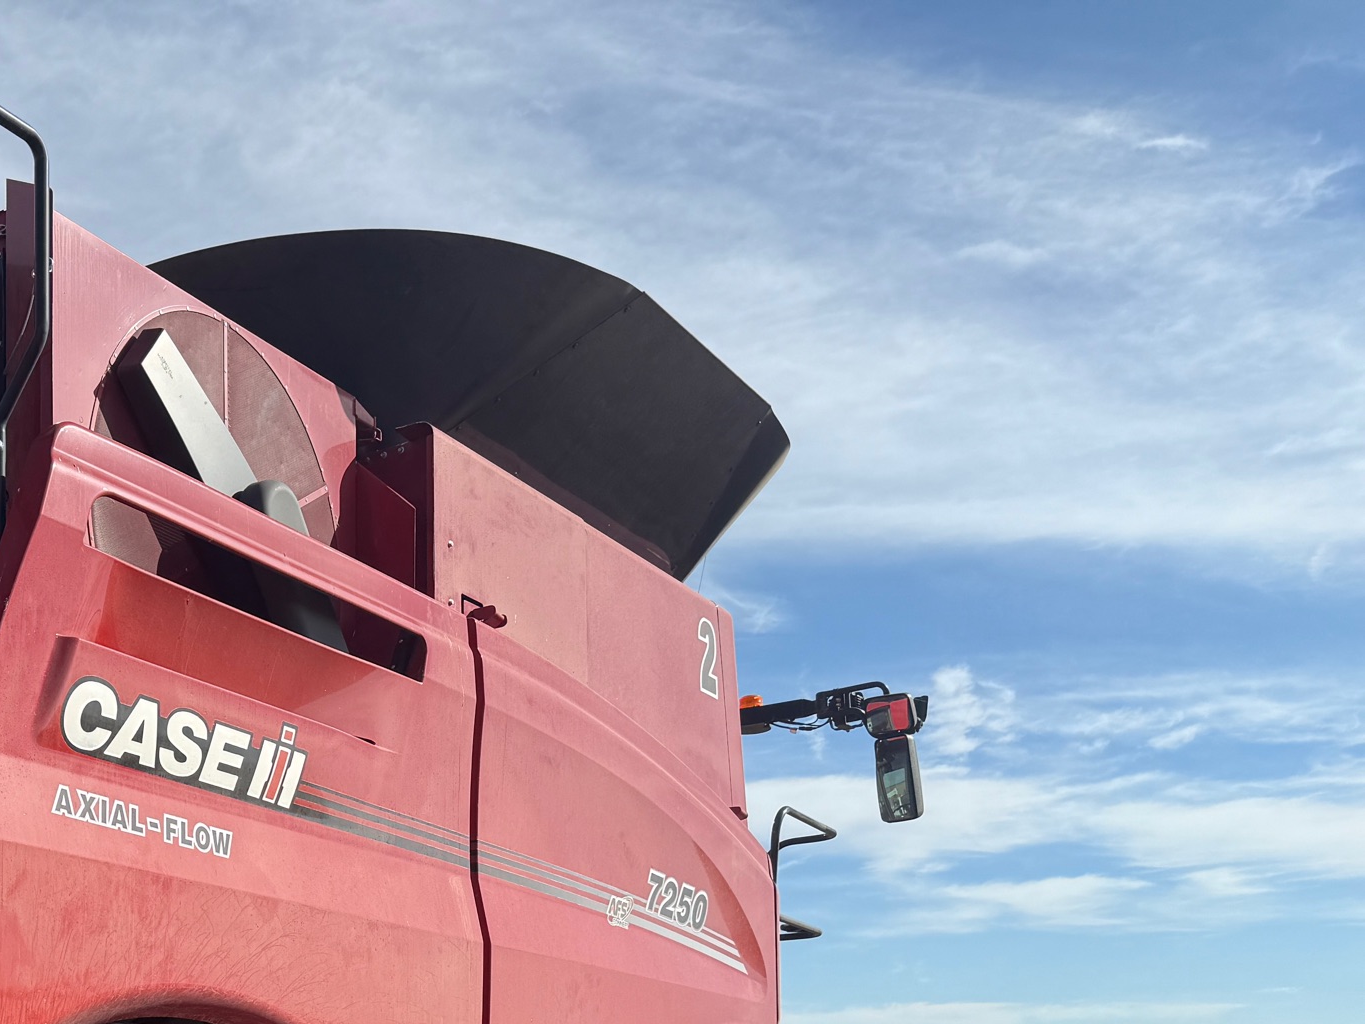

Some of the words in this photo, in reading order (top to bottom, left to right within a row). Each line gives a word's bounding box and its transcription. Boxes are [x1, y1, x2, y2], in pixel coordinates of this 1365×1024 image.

[698, 617, 718, 700] 2
[63, 680, 252, 792] CASE
[51, 785, 233, 859] AXIAL-FLOW
[646, 868, 708, 932] 7250
